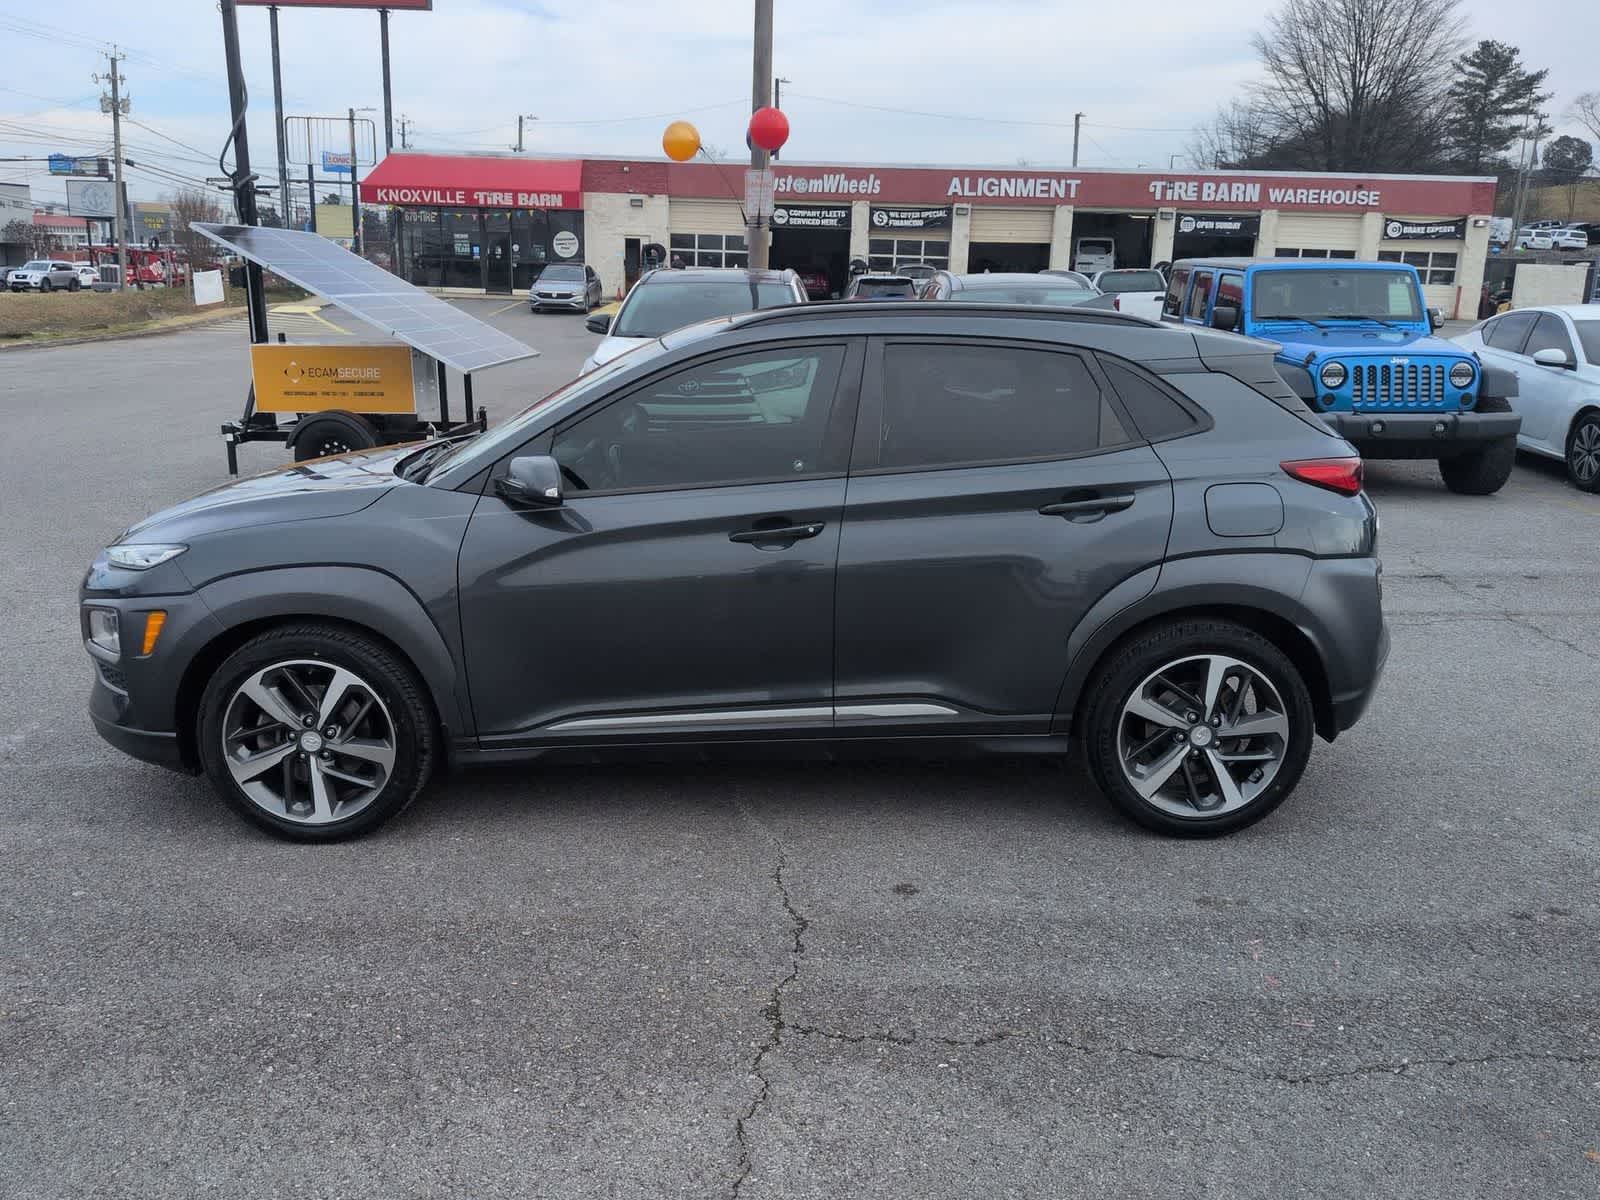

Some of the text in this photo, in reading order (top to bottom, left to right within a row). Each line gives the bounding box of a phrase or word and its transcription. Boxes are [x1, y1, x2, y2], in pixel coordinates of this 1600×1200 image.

[774, 173, 881, 194] ustomWheels
[947, 177, 1081, 198] ALIGNMENT
[377, 188, 563, 207] KNOXVILLE TIRE BARN
[1149, 181, 1381, 206] TIRE BARN WAREHOUSE
[789, 209, 847, 218] COMPANY FLEETS
[921, 210, 948, 218] SPECIAL
[789, 218, 839, 226] SERVICED HERE
[1196, 221, 1242, 230] OPEN SUNDAY
[308, 367, 381, 378] ECAMSECURE
